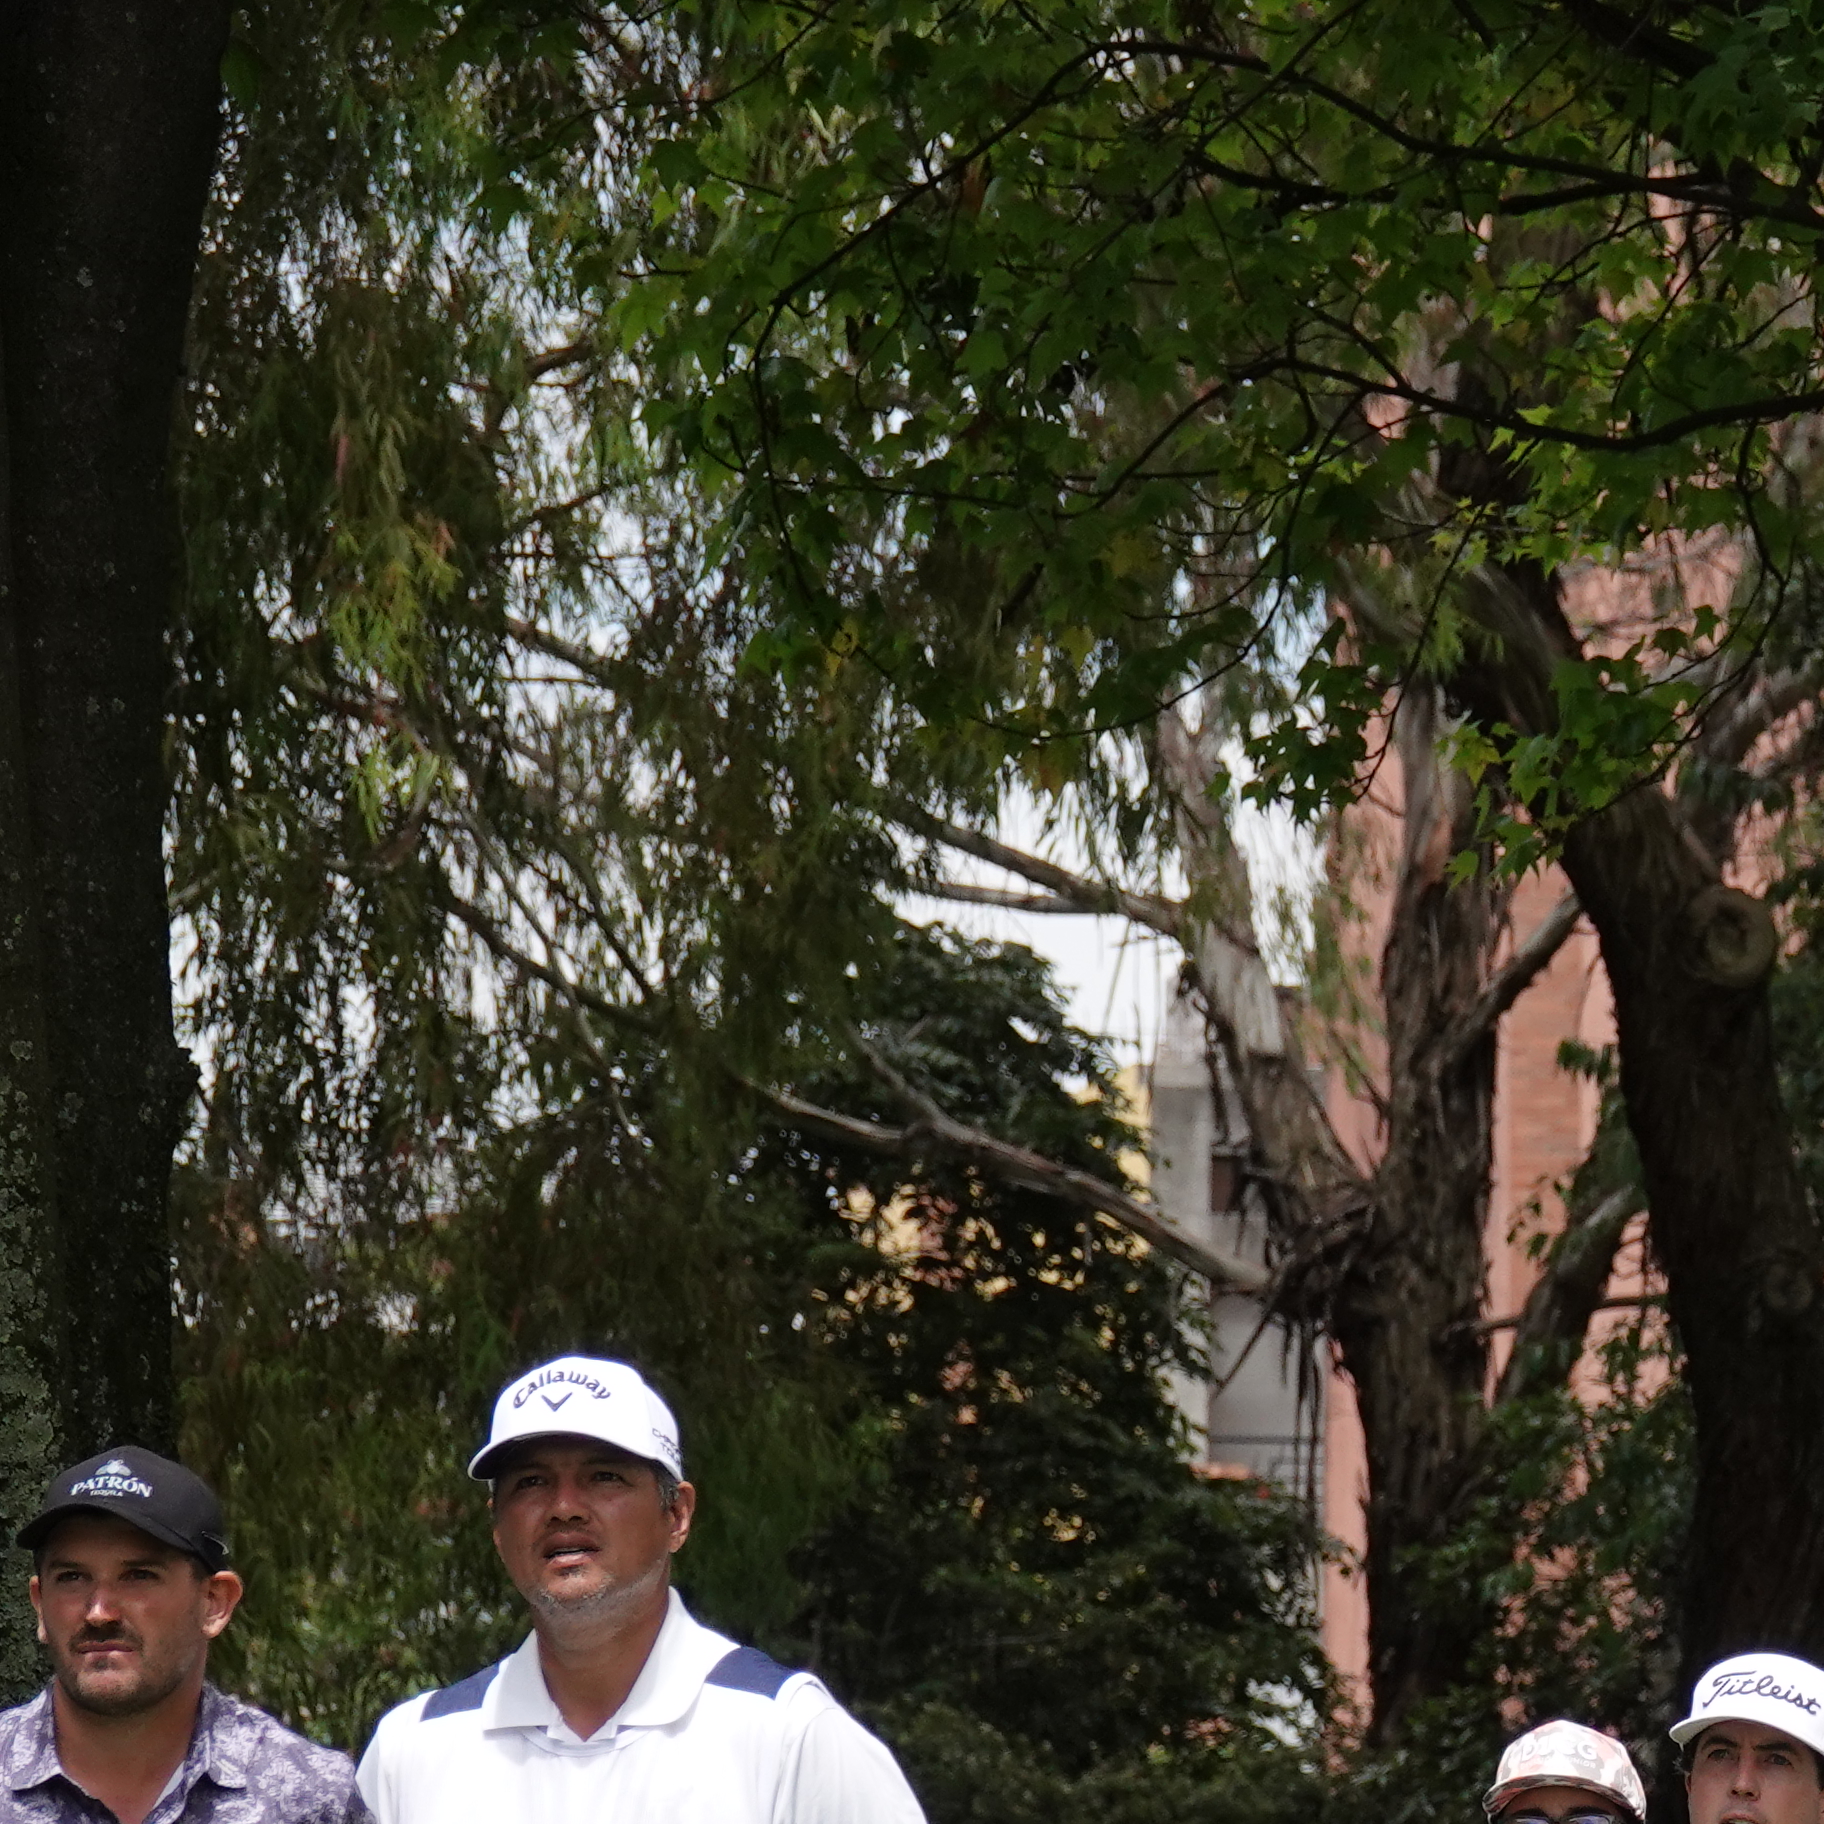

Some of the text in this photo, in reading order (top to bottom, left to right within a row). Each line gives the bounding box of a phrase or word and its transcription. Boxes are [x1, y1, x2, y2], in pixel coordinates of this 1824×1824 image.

[513, 1369, 612, 1409] Callaway
[70, 1476, 153, 1498] PATRÓN
[1702, 1670, 1822, 1716] Titleist
